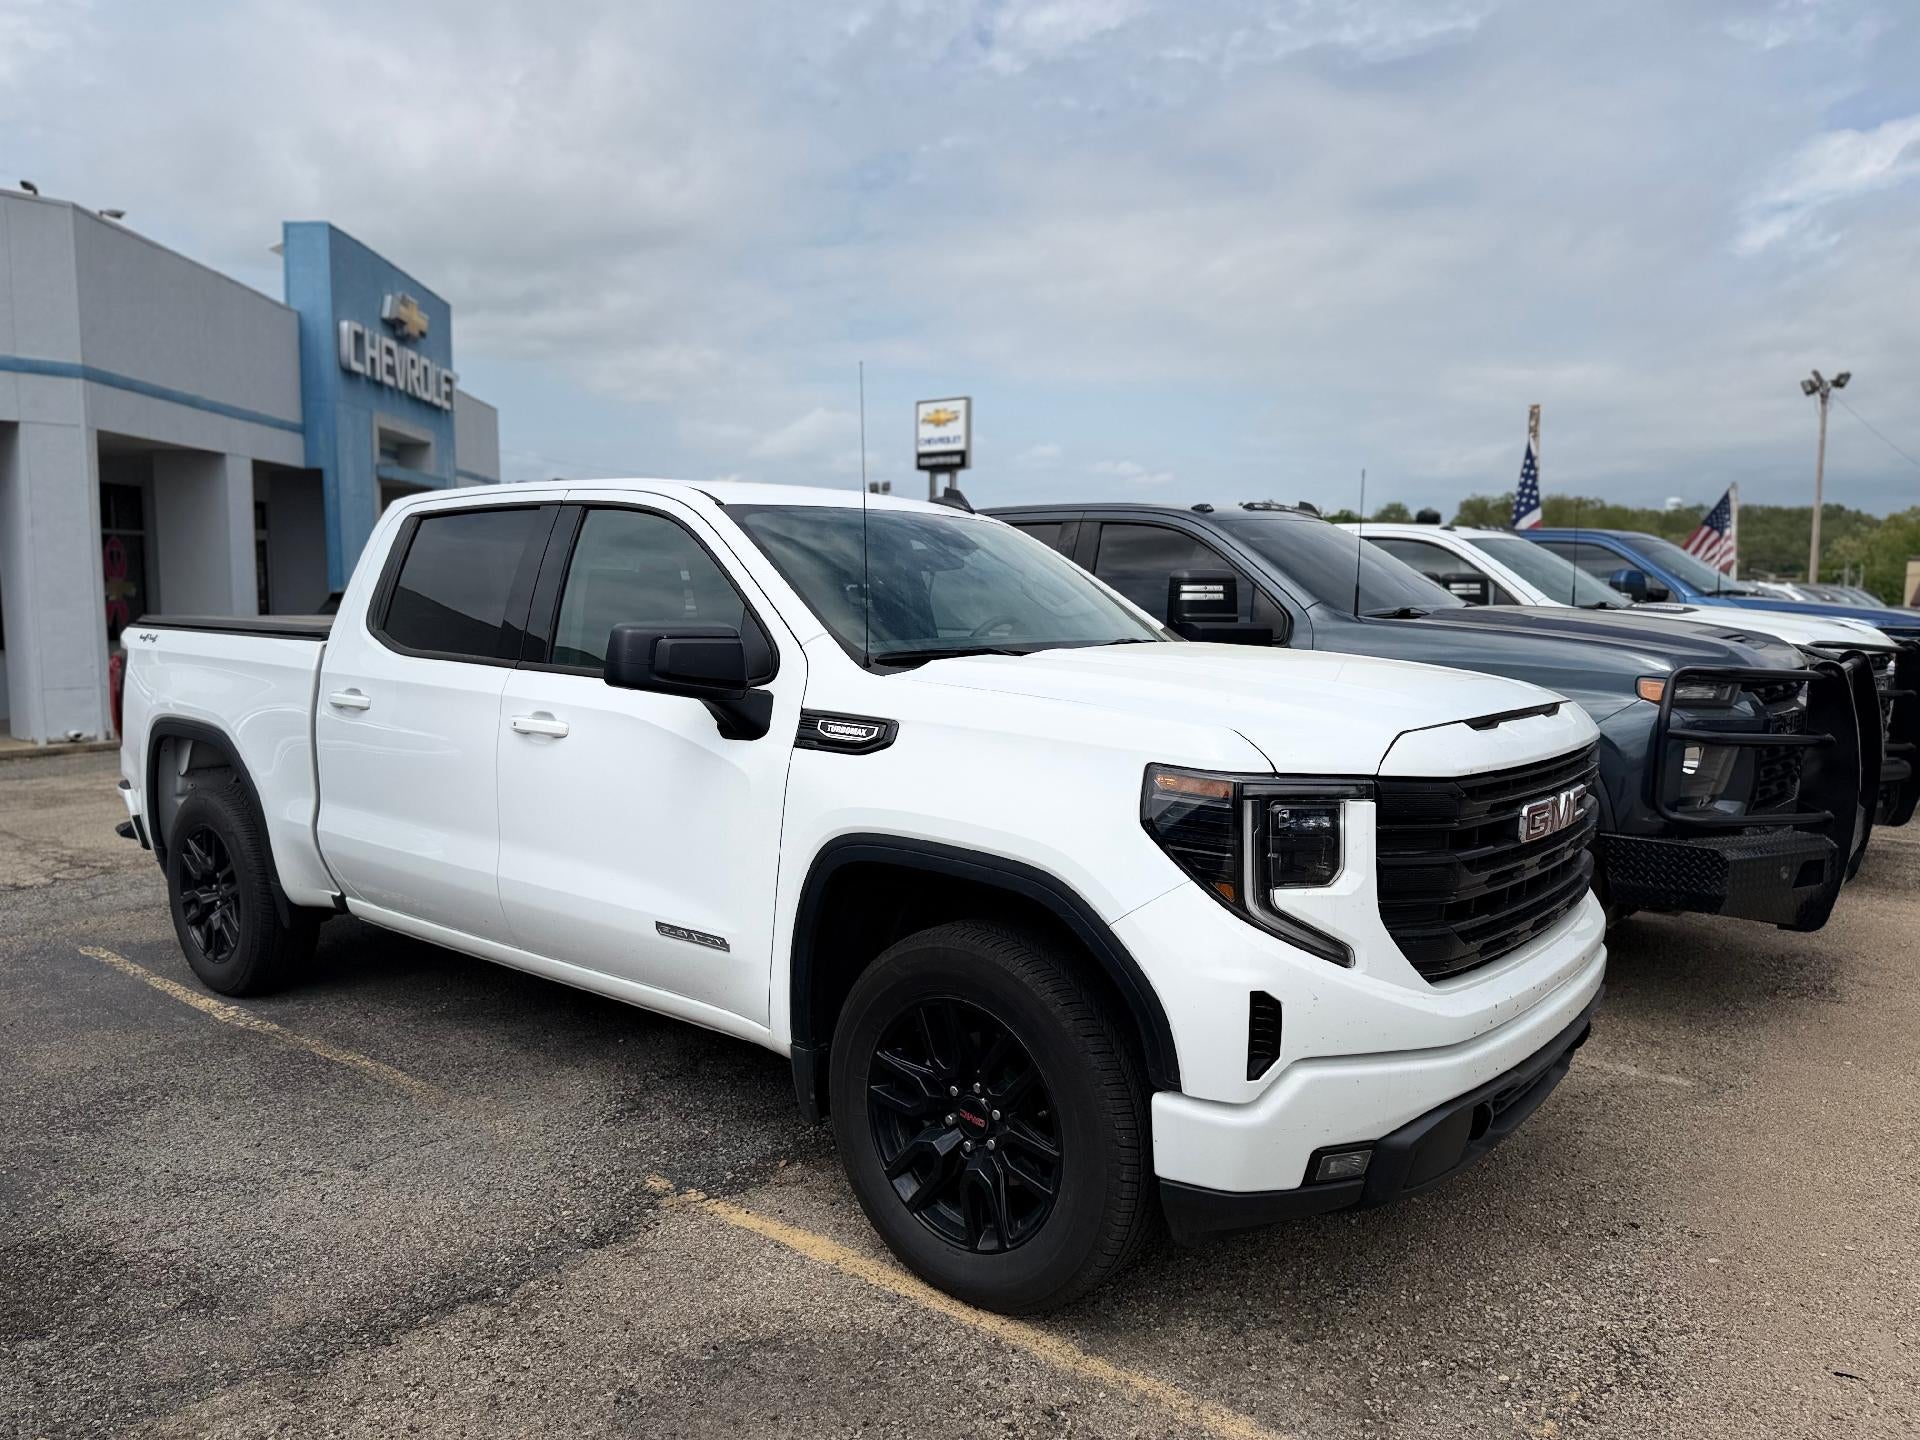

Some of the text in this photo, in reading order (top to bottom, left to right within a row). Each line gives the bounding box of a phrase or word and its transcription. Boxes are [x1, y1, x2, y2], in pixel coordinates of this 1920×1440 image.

[339, 320, 459, 412] CHEVROLET
[827, 724, 867, 737] TURBOMAX
[1520, 784, 1587, 843] GMC
